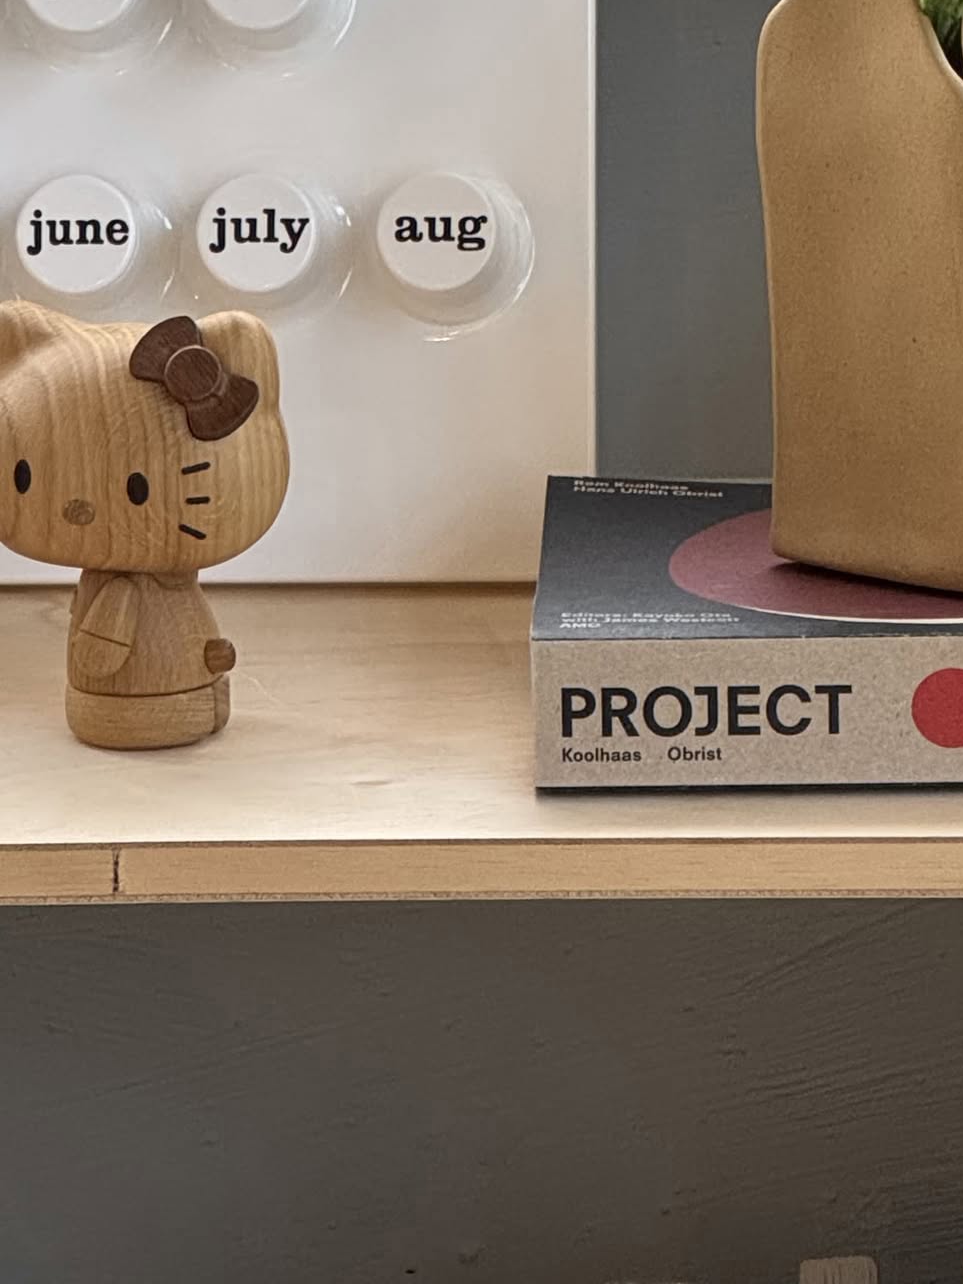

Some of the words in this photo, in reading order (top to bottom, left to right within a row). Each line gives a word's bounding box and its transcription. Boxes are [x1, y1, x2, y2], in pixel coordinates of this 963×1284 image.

[26, 209, 129, 256] june
[209, 207, 310, 254] july
[394, 215, 488, 252] aug
[561, 684, 853, 738] PROJECT
[562, 747, 642, 763] Koolhaas
[667, 746, 722, 762] Obrist
